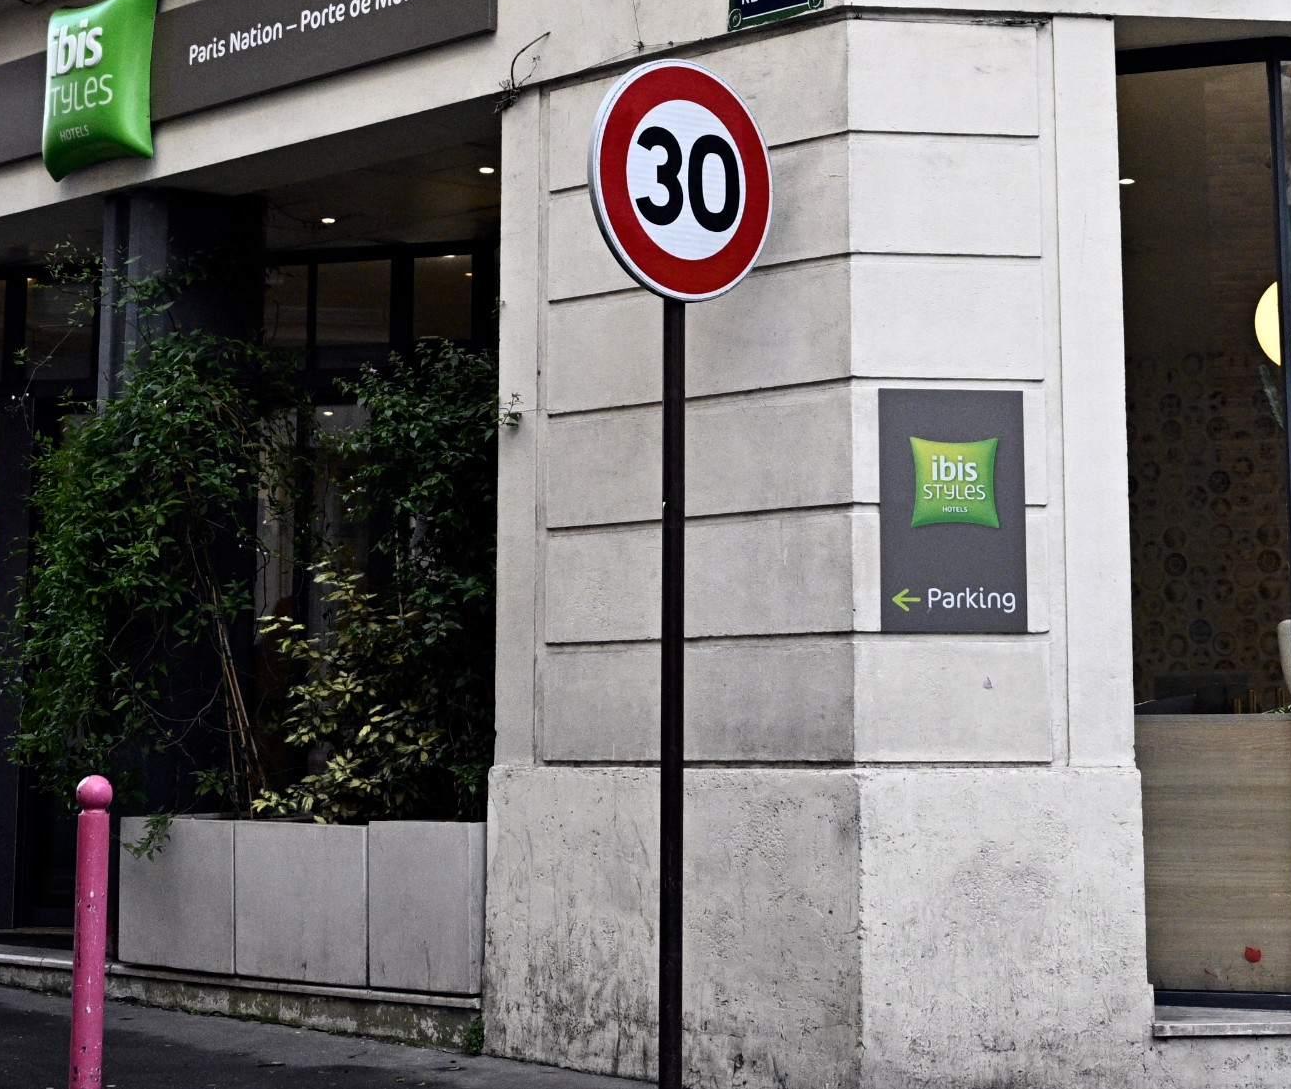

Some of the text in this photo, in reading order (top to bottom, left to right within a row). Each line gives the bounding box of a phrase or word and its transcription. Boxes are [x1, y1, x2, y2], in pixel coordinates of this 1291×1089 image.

[49, 18, 103, 78] ibis
[189, 37, 226, 65] Paris
[229, 23, 283, 53] Nation
[300, 3, 346, 32] Porte
[60, 124, 90, 142] HOTELS
[635, 125, 741, 233] 30
[931, 455, 978, 481] ibis
[927, 587, 1016, 613] Parking
